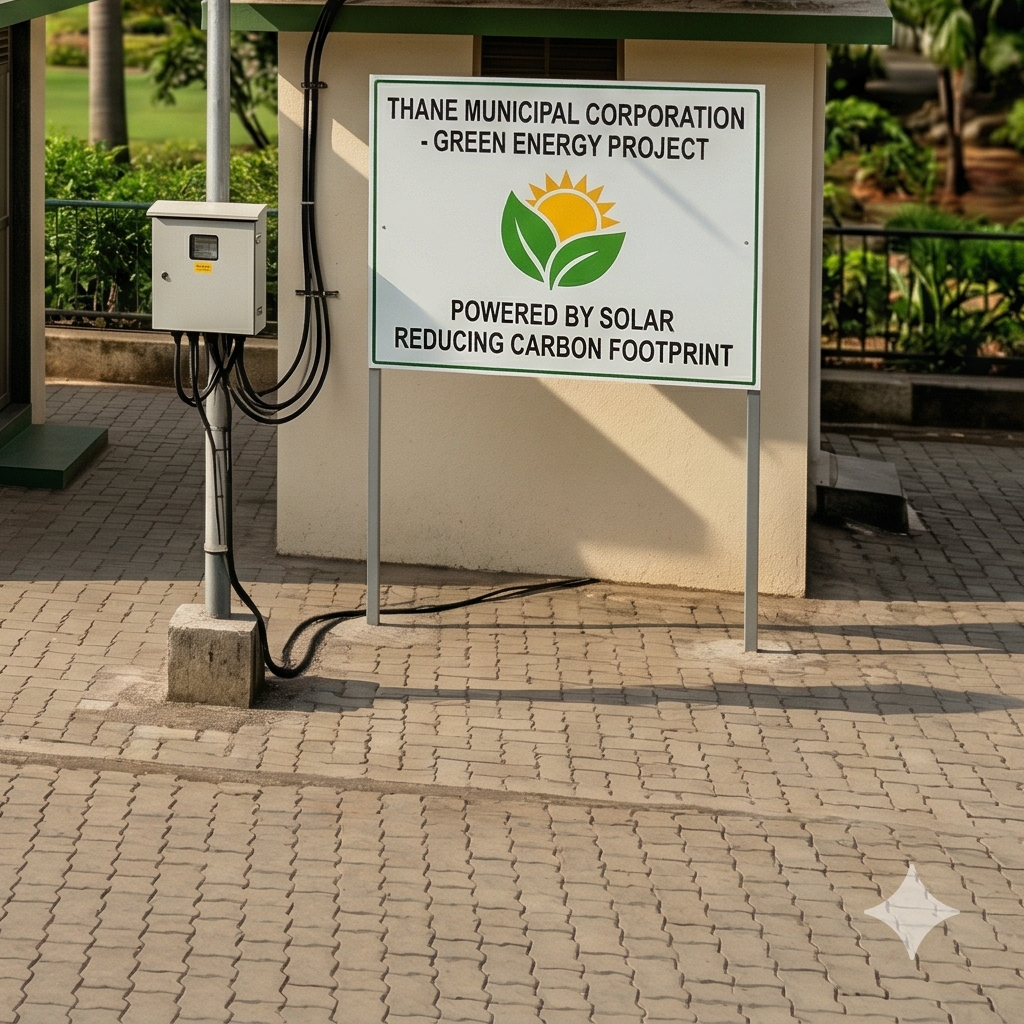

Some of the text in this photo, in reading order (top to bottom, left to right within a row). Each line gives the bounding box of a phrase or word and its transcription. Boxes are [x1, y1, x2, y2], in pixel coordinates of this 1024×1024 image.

[387, 97, 745, 129] THANE MUNICIPAL CORPORATION
[433, 129, 506, 154] GREEN
[513, 132, 602, 157] ENERGY
[608, 135, 709, 160] PROJECT
[451, 299, 674, 332] POWERED BY SOLAR
[394, 326, 734, 367] REDUCING CARBON FOOTPRINT
